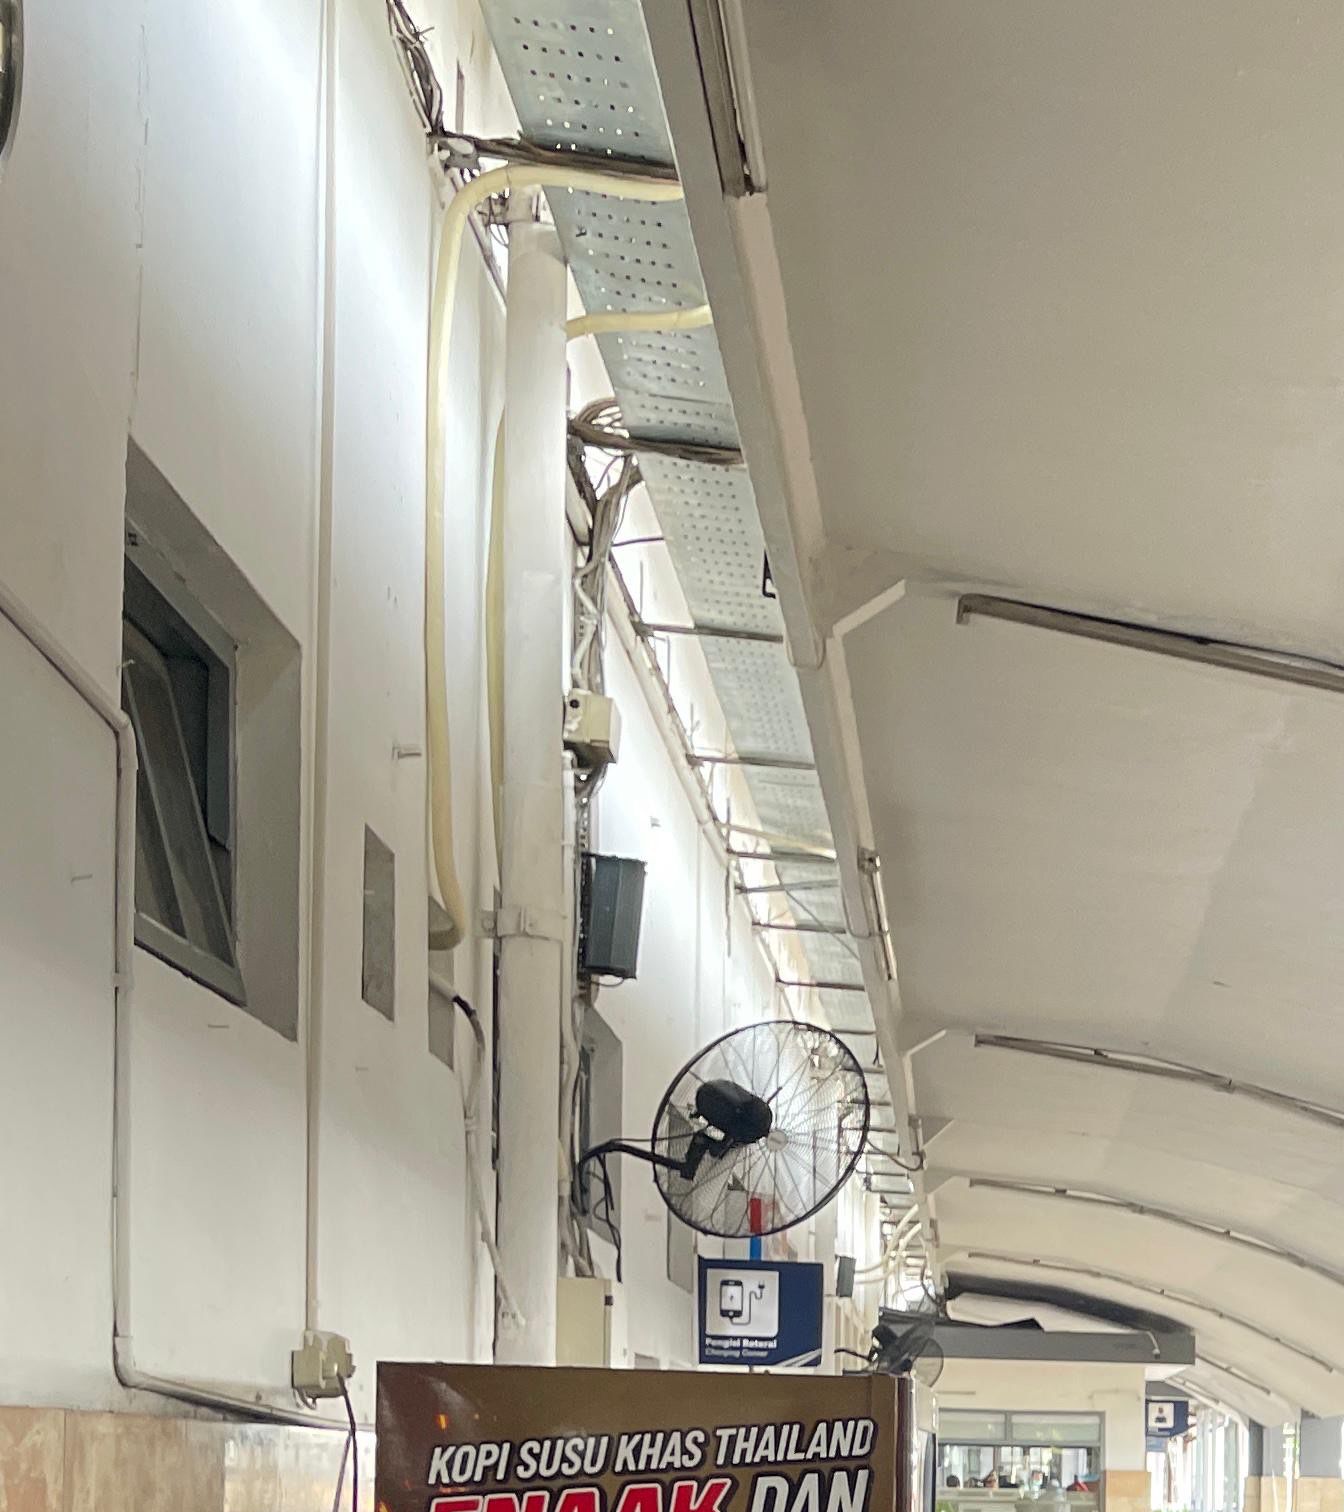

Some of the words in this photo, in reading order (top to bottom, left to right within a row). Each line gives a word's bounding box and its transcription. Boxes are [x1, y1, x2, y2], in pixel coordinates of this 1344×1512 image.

[427, 1442, 510, 1485] KOPI
[516, 1436, 609, 1479] SUSU
[614, 1429, 704, 1472] KHAS
[715, 1419, 874, 1465] THAILAND
